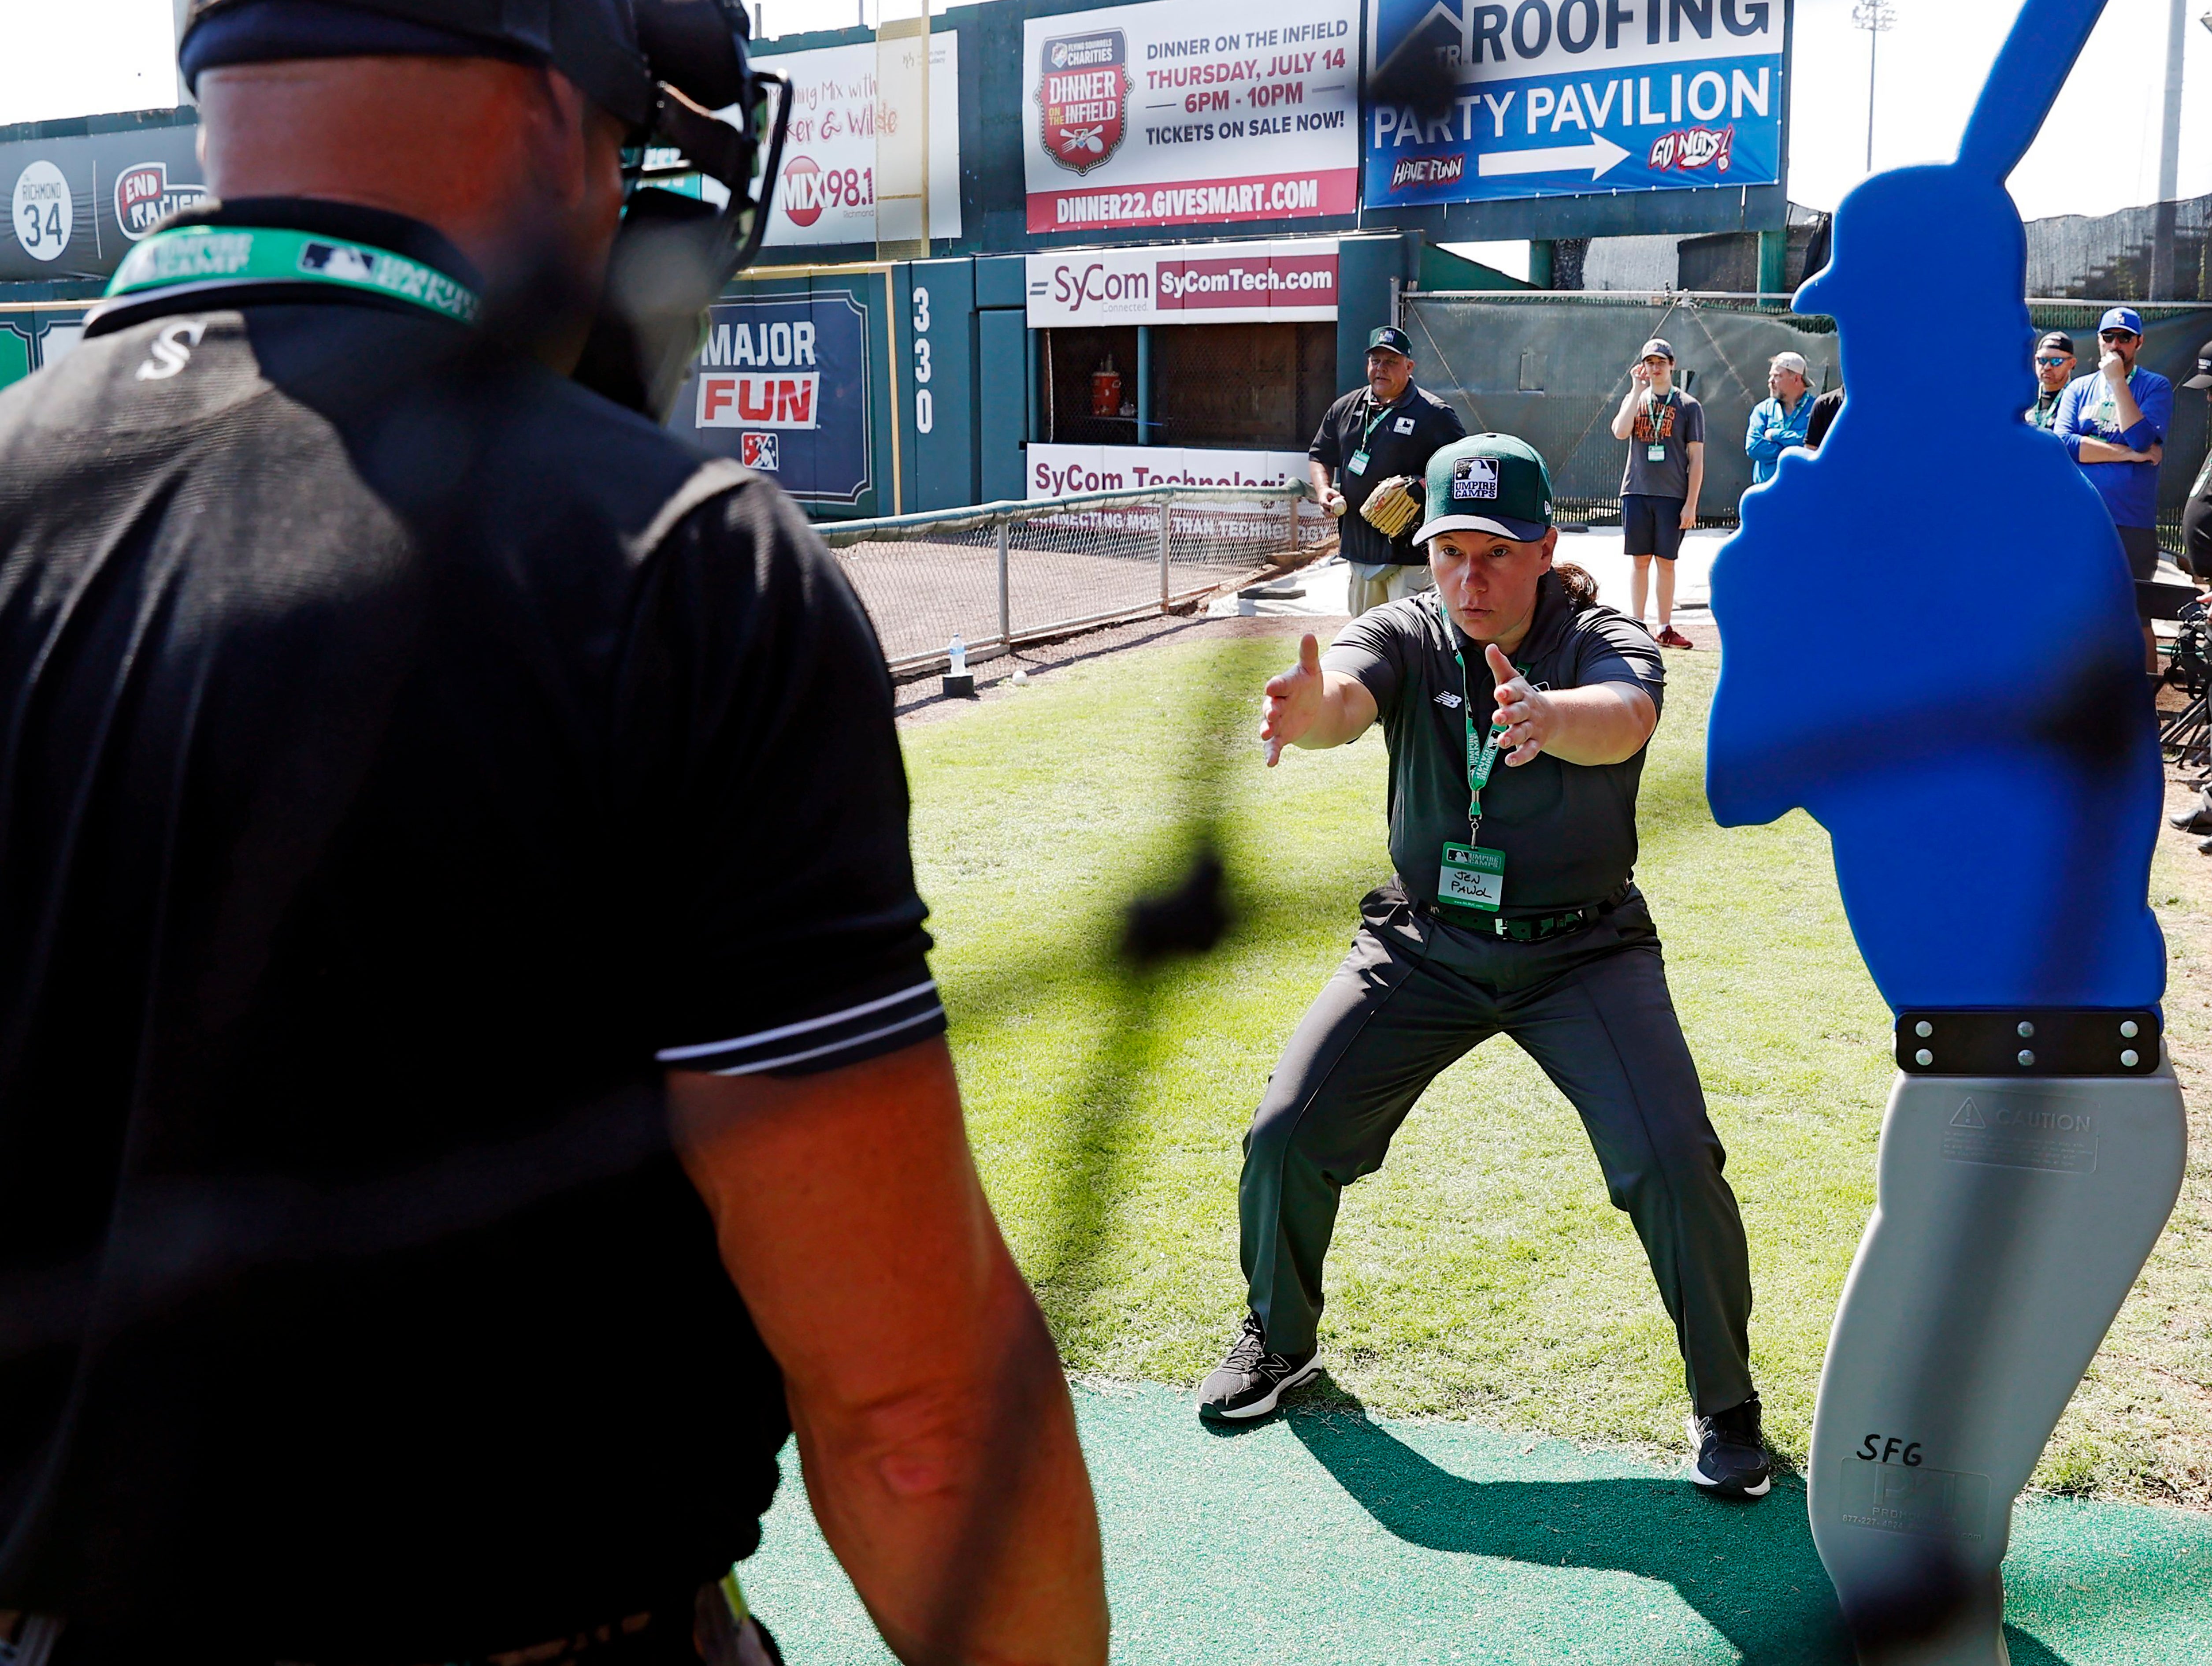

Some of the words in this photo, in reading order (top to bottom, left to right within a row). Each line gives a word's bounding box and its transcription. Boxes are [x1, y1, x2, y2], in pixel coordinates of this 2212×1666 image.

[1147, 38, 1210, 60] DINNER
[1215, 34, 1240, 52] ON
[1246, 30, 1277, 48] THE
[1284, 19, 1348, 44] INFIELD
[1472, 0, 1770, 63] ROOFING
[1067, 48, 1113, 66] CHARITIES
[1147, 59, 1261, 89] THURSDAY,
[1267, 52, 1317, 77] JULY
[1321, 48, 1346, 70] 14
[821, 80, 843, 101] Mix
[848, 73, 877, 98] with
[1049, 71, 1117, 104] DINNER
[1185, 90, 1229, 113] 6PM
[1247, 82, 1303, 108] 10PM
[1048, 107, 1061, 117] ON
[1049, 115, 1065, 126] THE
[1065, 100, 1117, 124] INFIELD
[1374, 90, 1515, 149] PARTY
[1527, 67, 1770, 134] PAVILION
[1146, 123, 1214, 145] TICKETS
[1218, 121, 1244, 139] ON
[1249, 116, 1291, 136] SALE
[1297, 111, 1344, 132] NOW!
[1650, 134, 1675, 168] GO
[1392, 160, 1429, 186] HAVE
[1429, 157, 1462, 181] FUNN
[22, 182, 62, 202] RICHMOND
[126, 174, 158, 204] END
[779, 171, 828, 211] MIX
[827, 167, 873, 207] 98.1
[1057, 178, 1318, 224] DINNER22.GIVESMART.COM
[23, 202, 62, 247] 34
[843, 209, 875, 218] Richmond
[1055, 264, 1148, 312] SyCom
[1160, 267, 1333, 298] SyComTech.com
[1102, 301, 1149, 313] Connected.
[701, 321, 817, 366] MAJOR
[705, 379, 811, 422] FUN
[1035, 463, 1123, 497] SyCom
[1455, 481, 1496, 491] UMPIRE
[1455, 489, 1496, 498] CAMPS
[1469, 852, 1499, 862] UMPIRE
[1469, 859, 1499, 868] CAMPS
[1454, 871, 1481, 884] JEN
[1996, 1108, 2091, 1132] CAUTION
[1856, 1434, 1922, 1467] SFG
